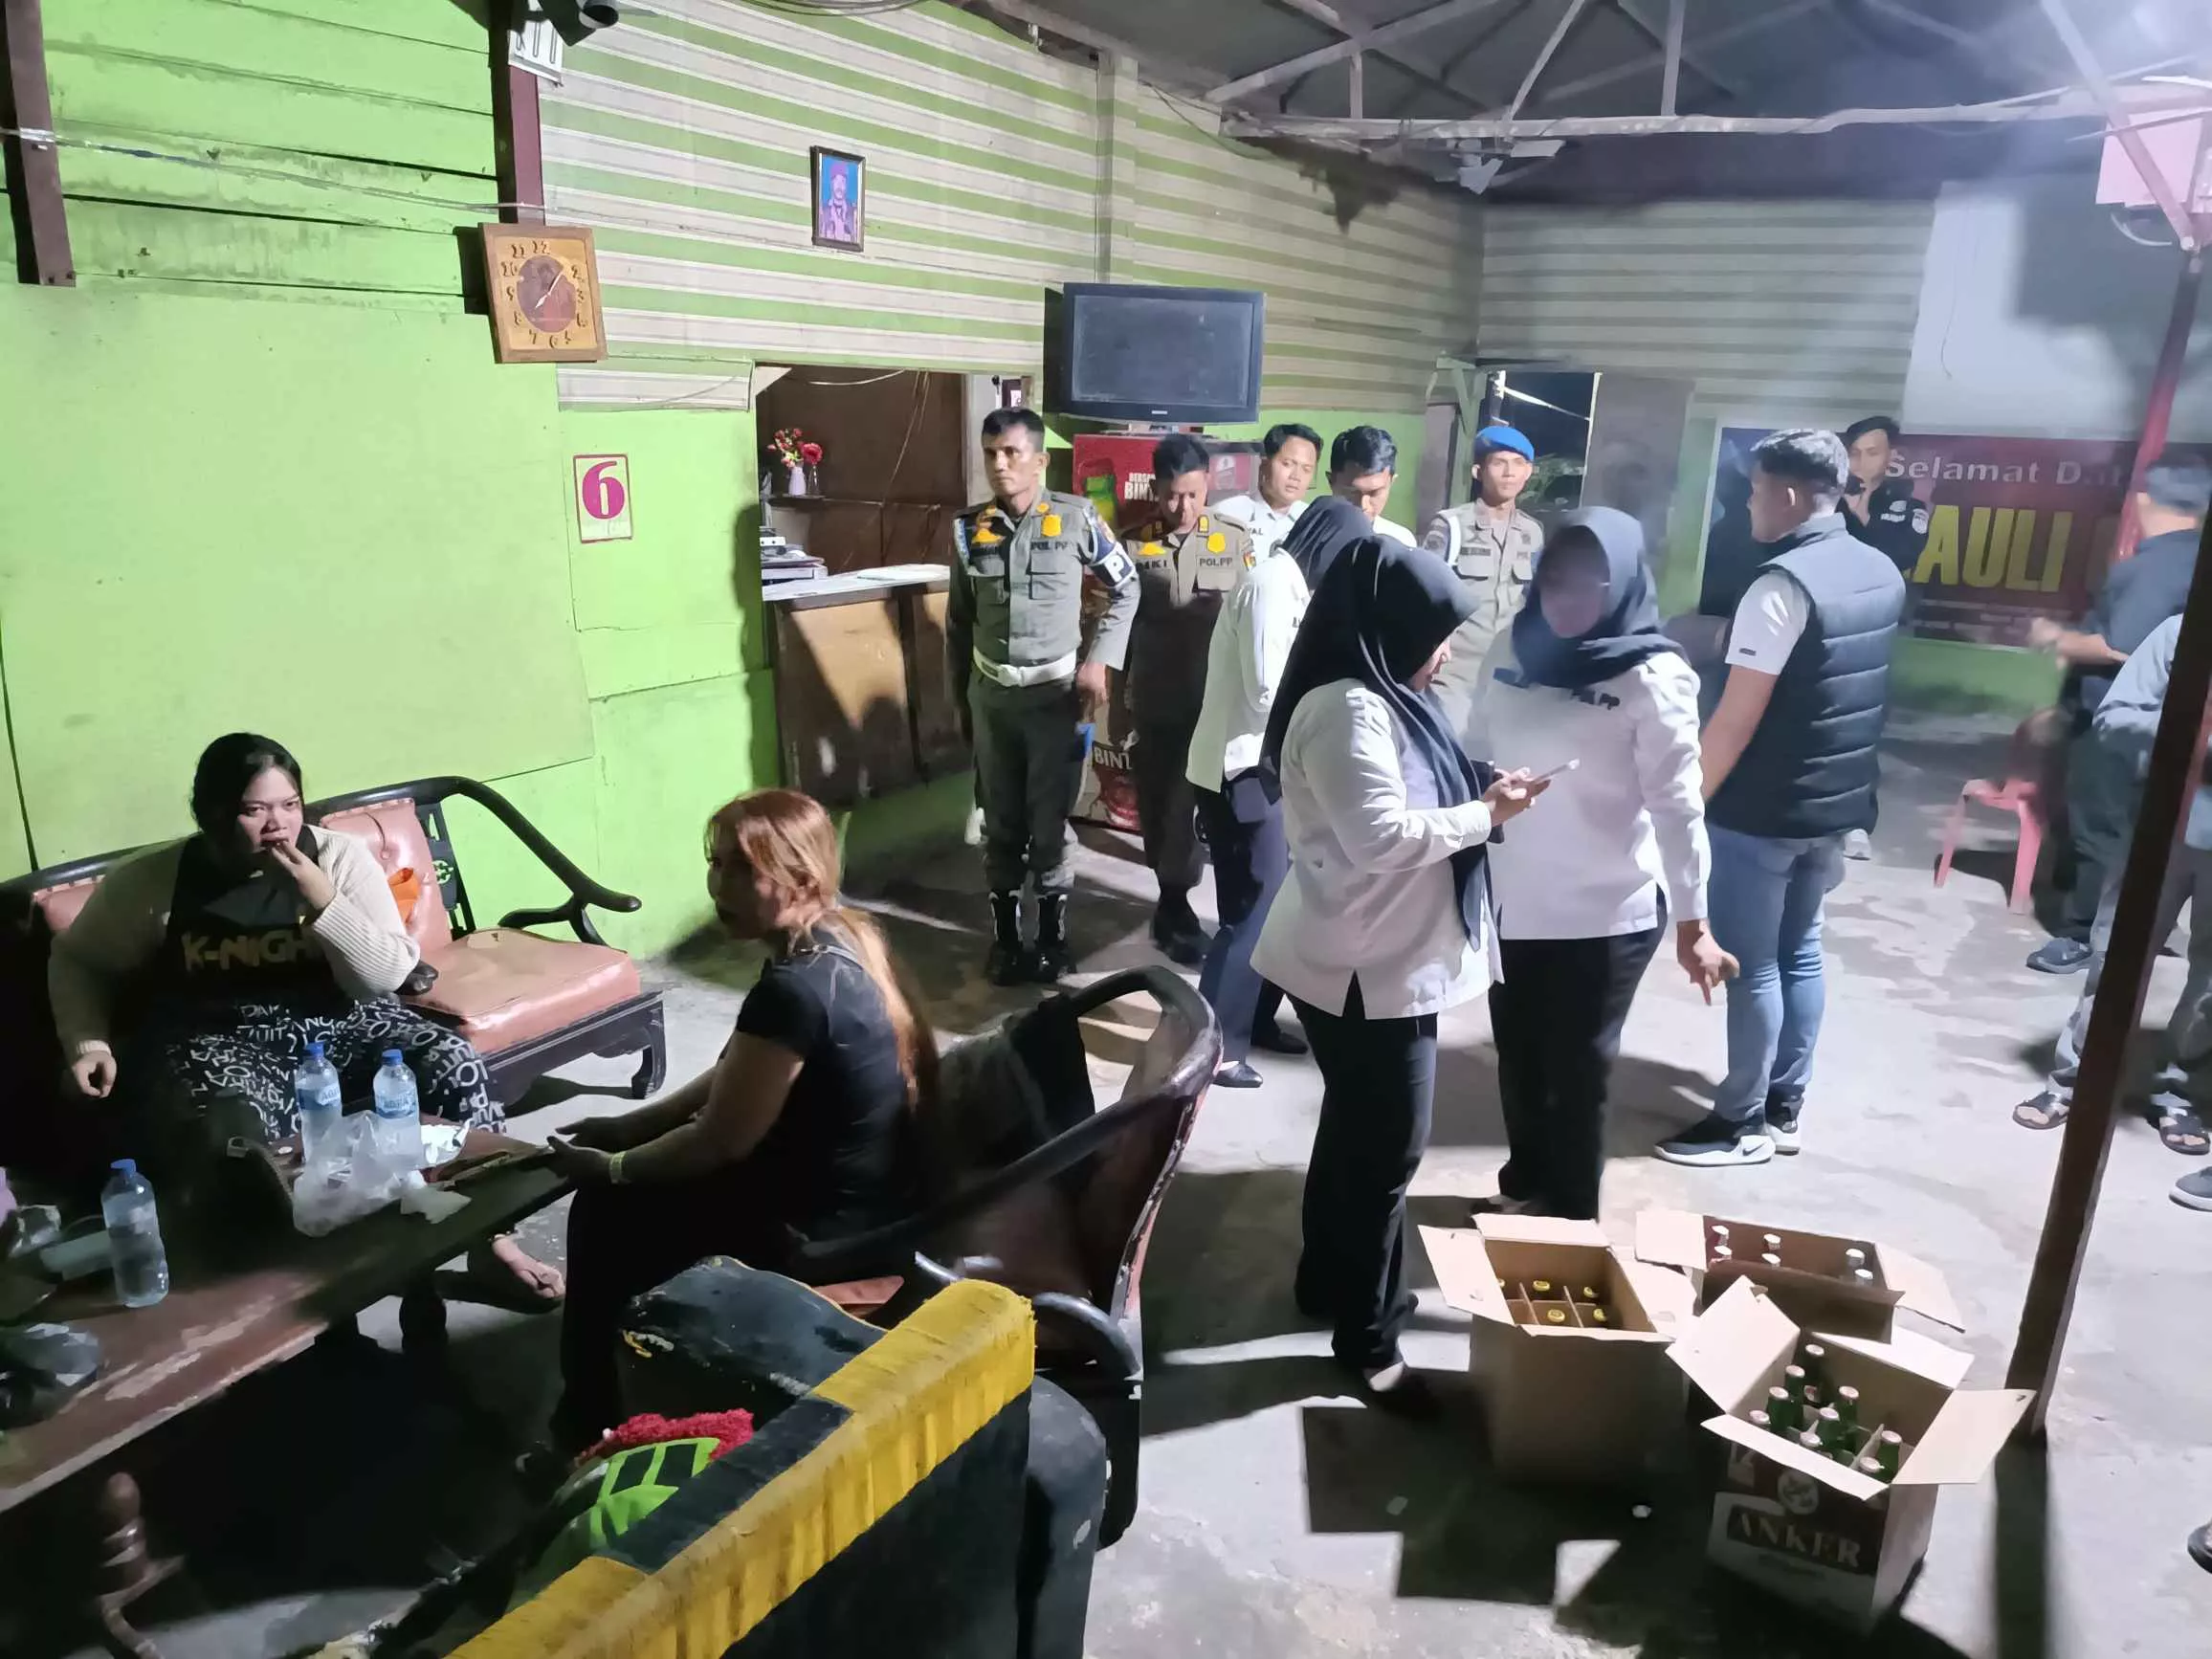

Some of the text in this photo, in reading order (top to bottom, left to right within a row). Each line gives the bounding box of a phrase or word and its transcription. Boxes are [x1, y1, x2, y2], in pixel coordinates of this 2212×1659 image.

[582, 460, 625, 519] 6
[1885, 451, 2040, 483] Selamat
[1903, 504, 2074, 592] AULI
